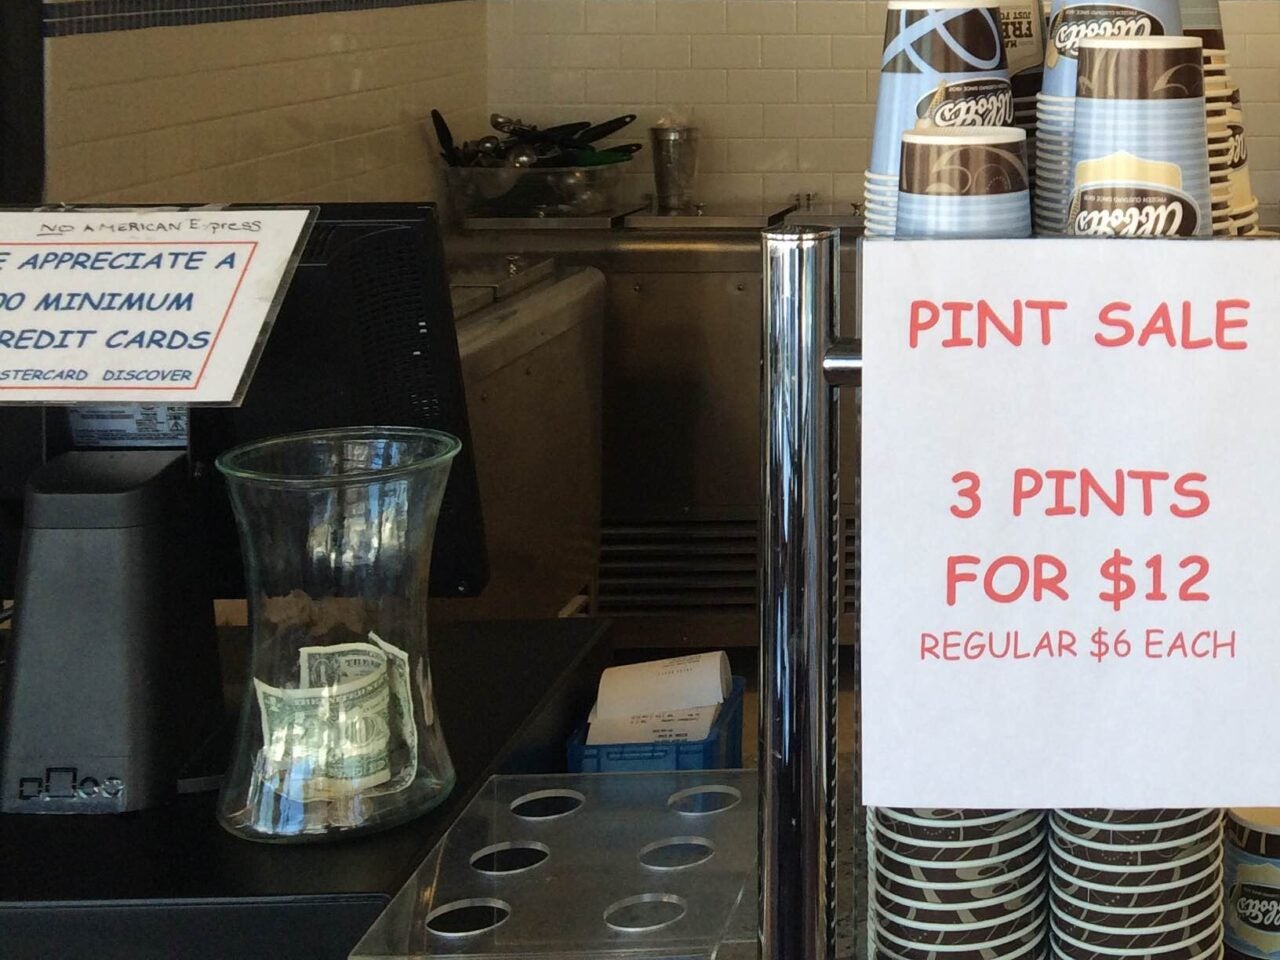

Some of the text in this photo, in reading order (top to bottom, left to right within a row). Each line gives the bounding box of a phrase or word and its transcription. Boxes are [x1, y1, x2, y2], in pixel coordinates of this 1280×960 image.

[1002, 20, 1033, 39] FRE
[39, 219, 262, 234] NO AMERICAN Epress
[17, 251, 236, 270] APPRECIATE A
[34, 292, 193, 311] MINIMUM
[909, 298, 1251, 351] PINT SALE
[105, 330, 213, 349] CARDS
[102, 369, 193, 381] DISCOVER
[949, 467, 1211, 519] 3 PINTS
[945, 548, 1211, 612] FOR $12
[920, 626, 1237, 663] REGULAR $6 EACH
